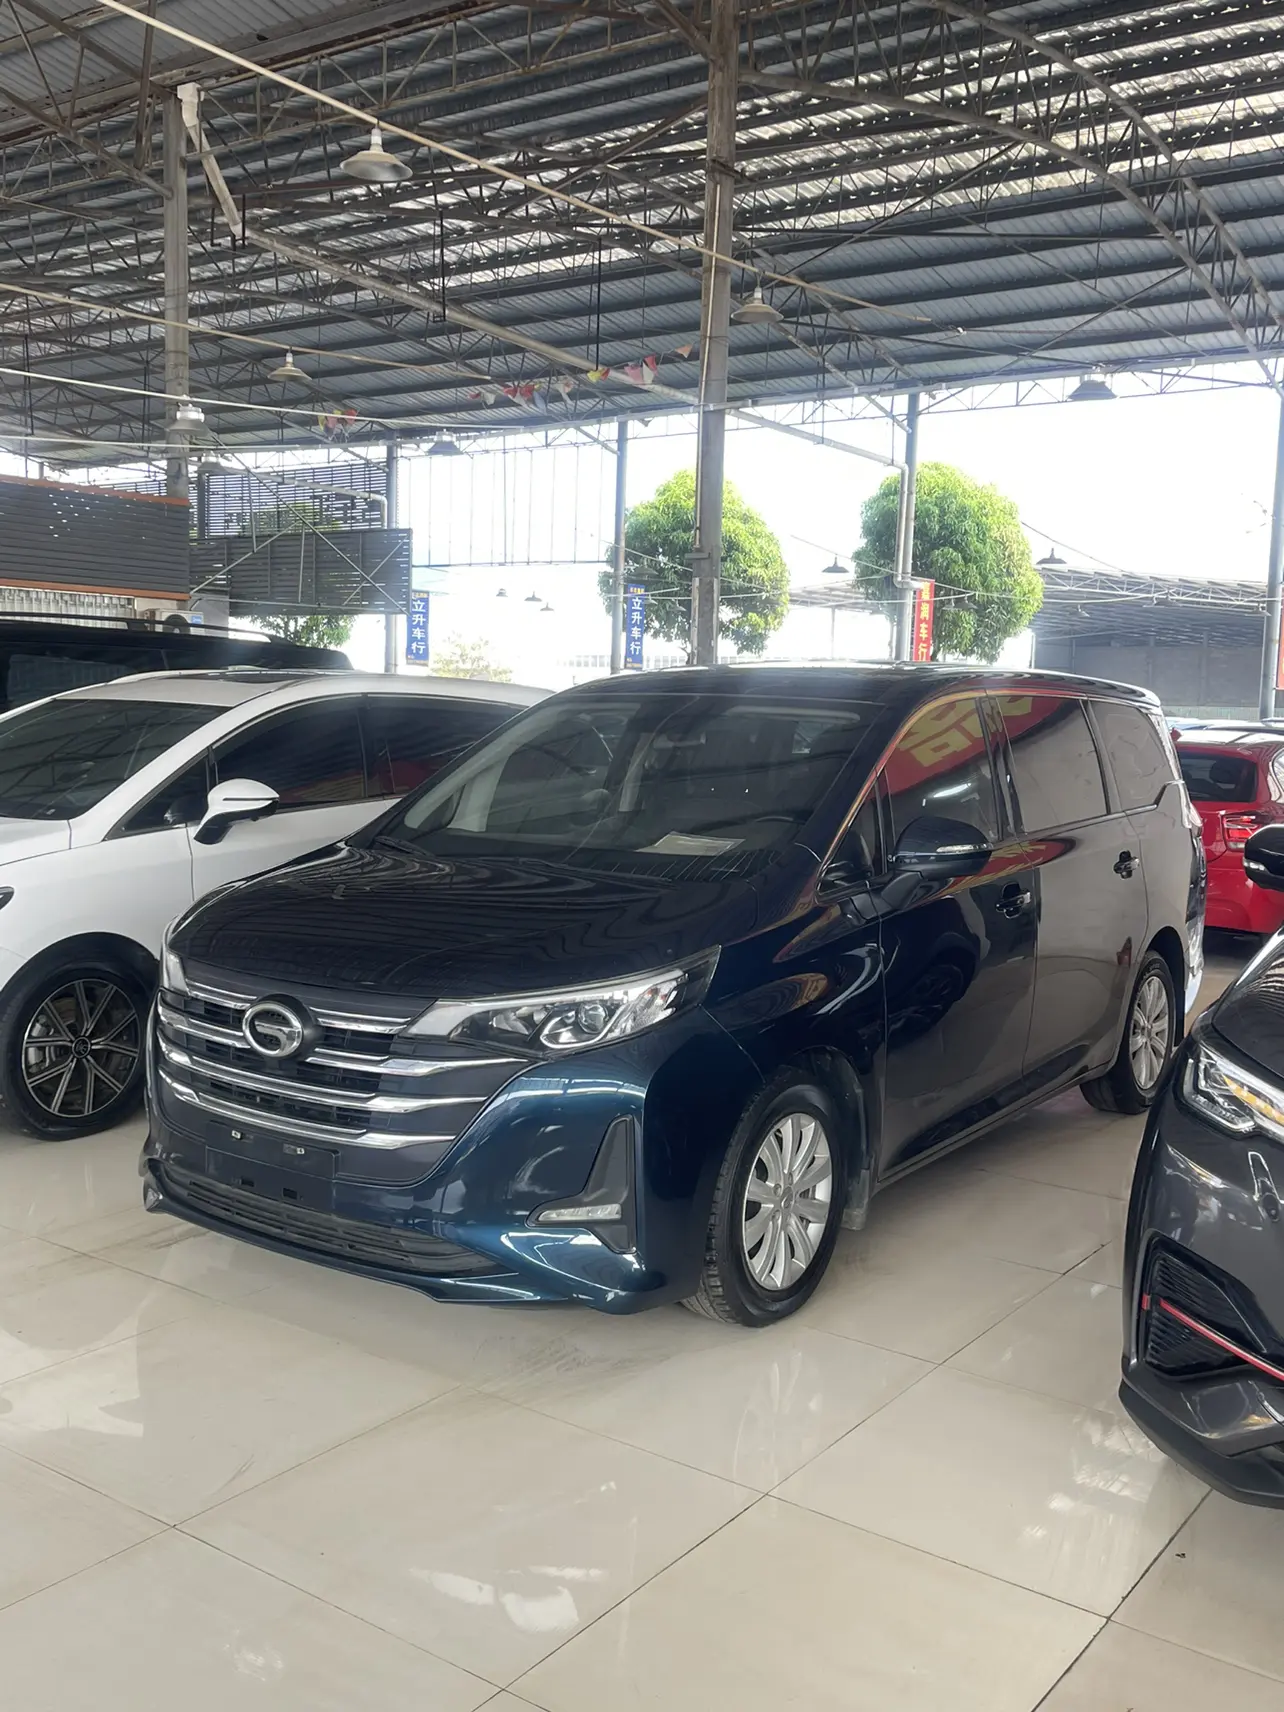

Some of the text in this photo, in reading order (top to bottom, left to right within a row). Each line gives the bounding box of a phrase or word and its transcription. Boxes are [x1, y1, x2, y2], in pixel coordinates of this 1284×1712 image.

[411, 599, 426, 654] 立升车行
[630, 596, 643, 655] 立升车行
